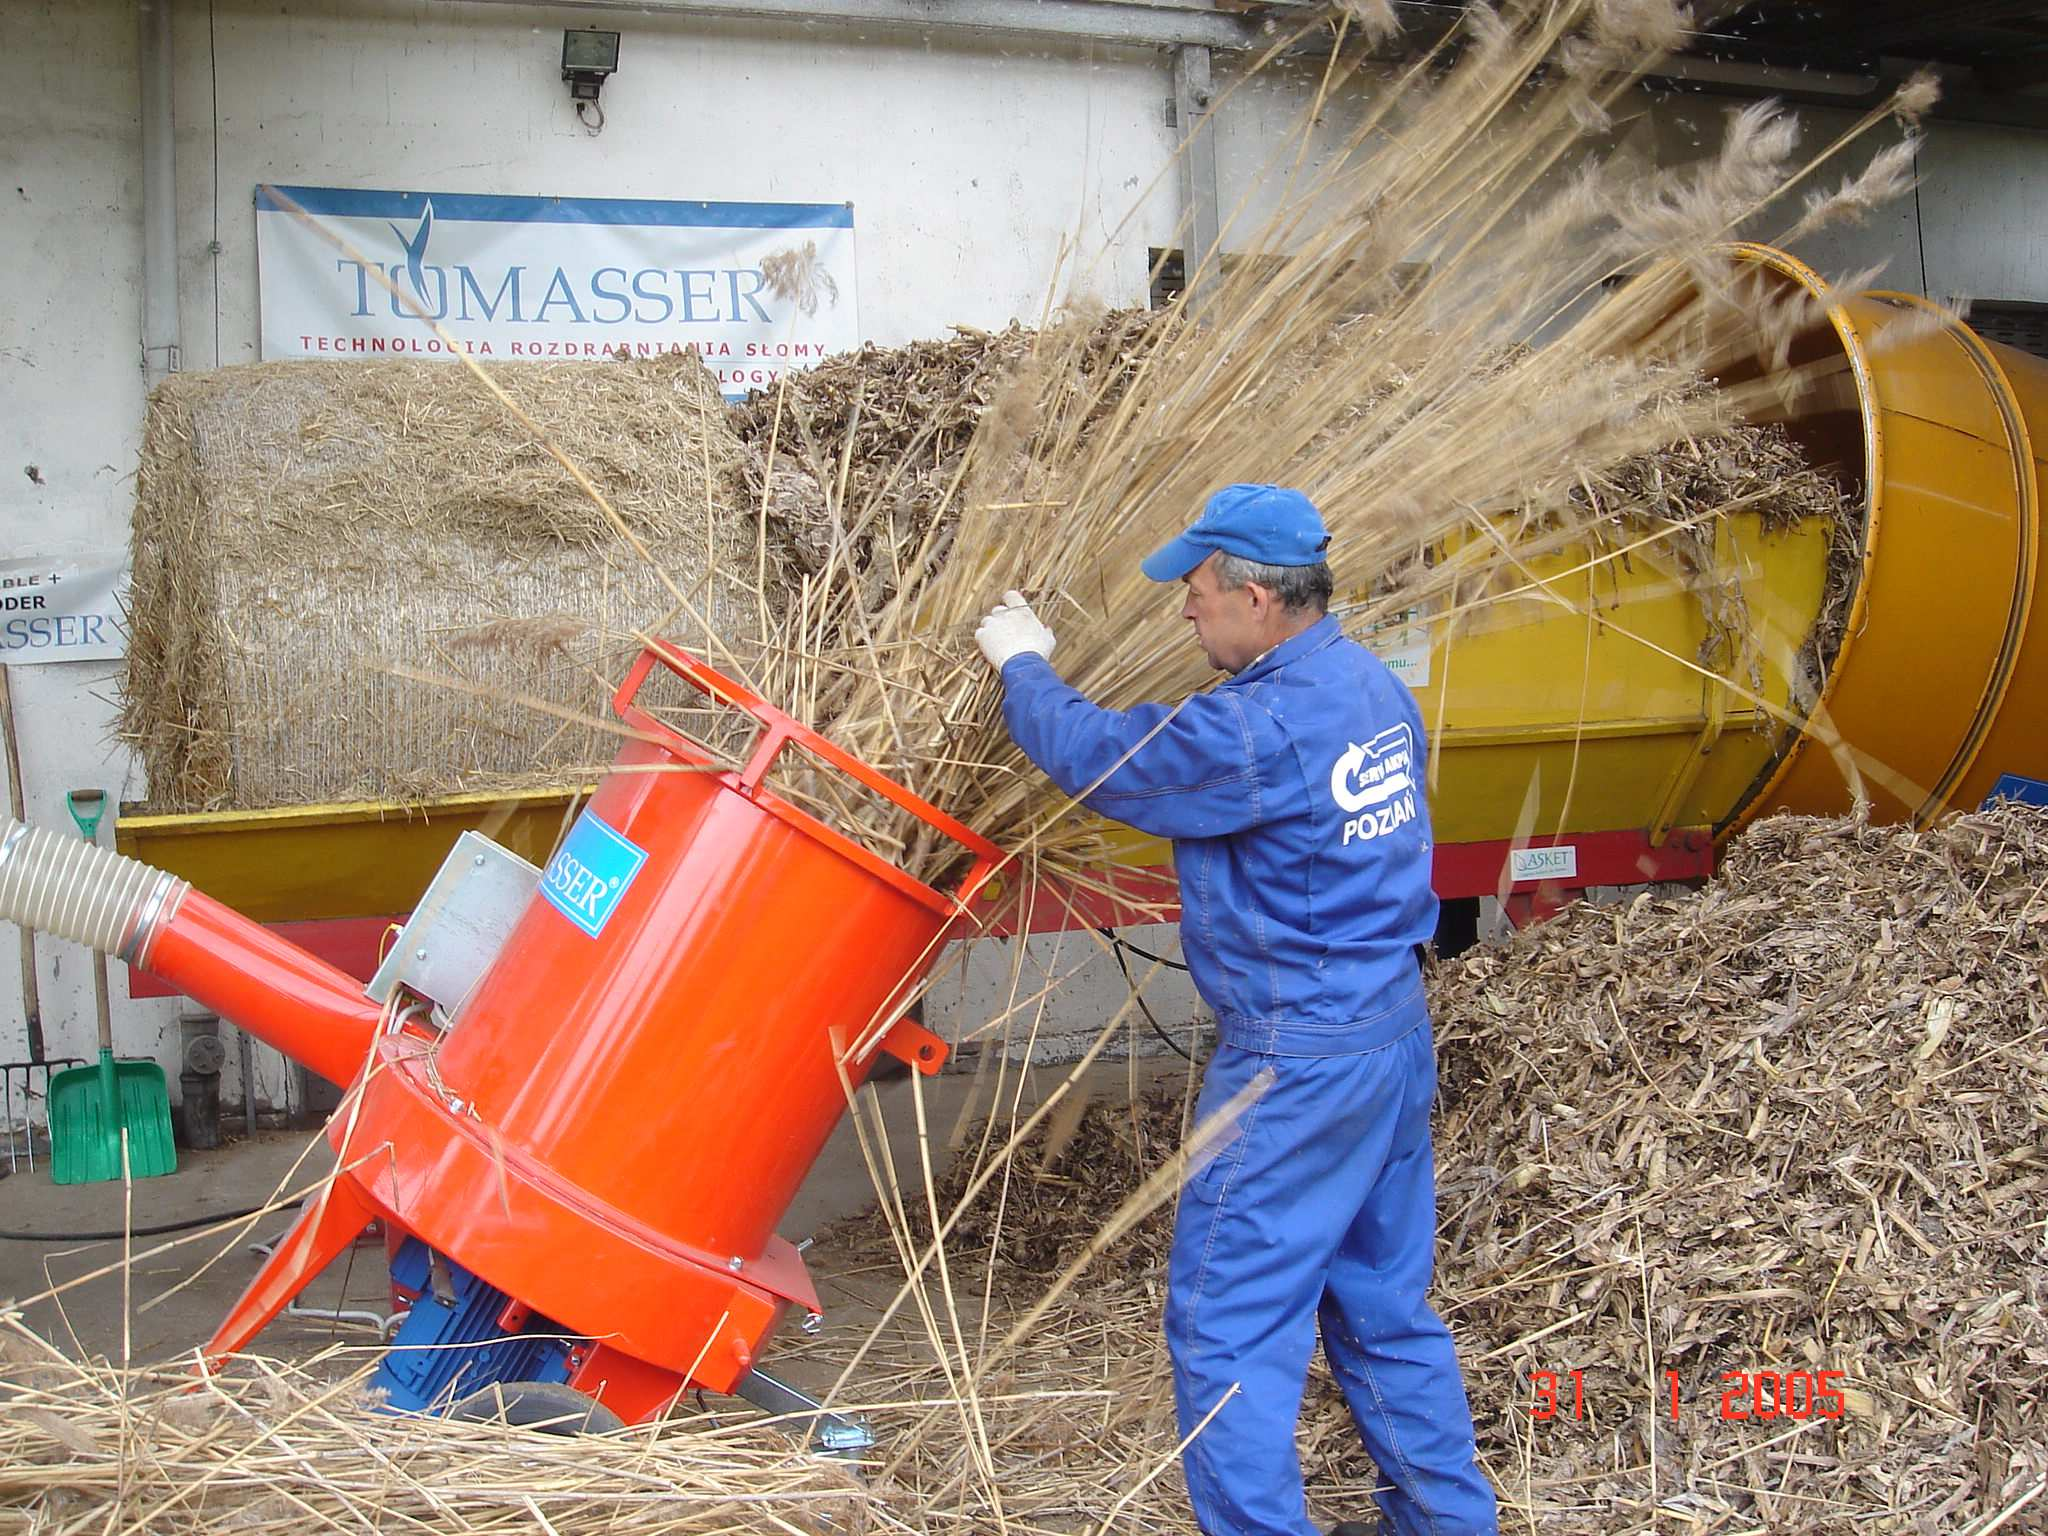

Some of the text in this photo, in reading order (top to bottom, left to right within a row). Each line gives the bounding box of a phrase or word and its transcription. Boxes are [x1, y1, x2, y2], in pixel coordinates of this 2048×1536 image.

[337, 259, 773, 324] TOMASSER
[746, 342, 825, 358] SŁOMY
[718, 369, 779, 384] LOGY
[0, 575, 41, 589] BLE
[0, 614, 107, 650] SSER
[1527, 851, 1569, 867] ASKET
